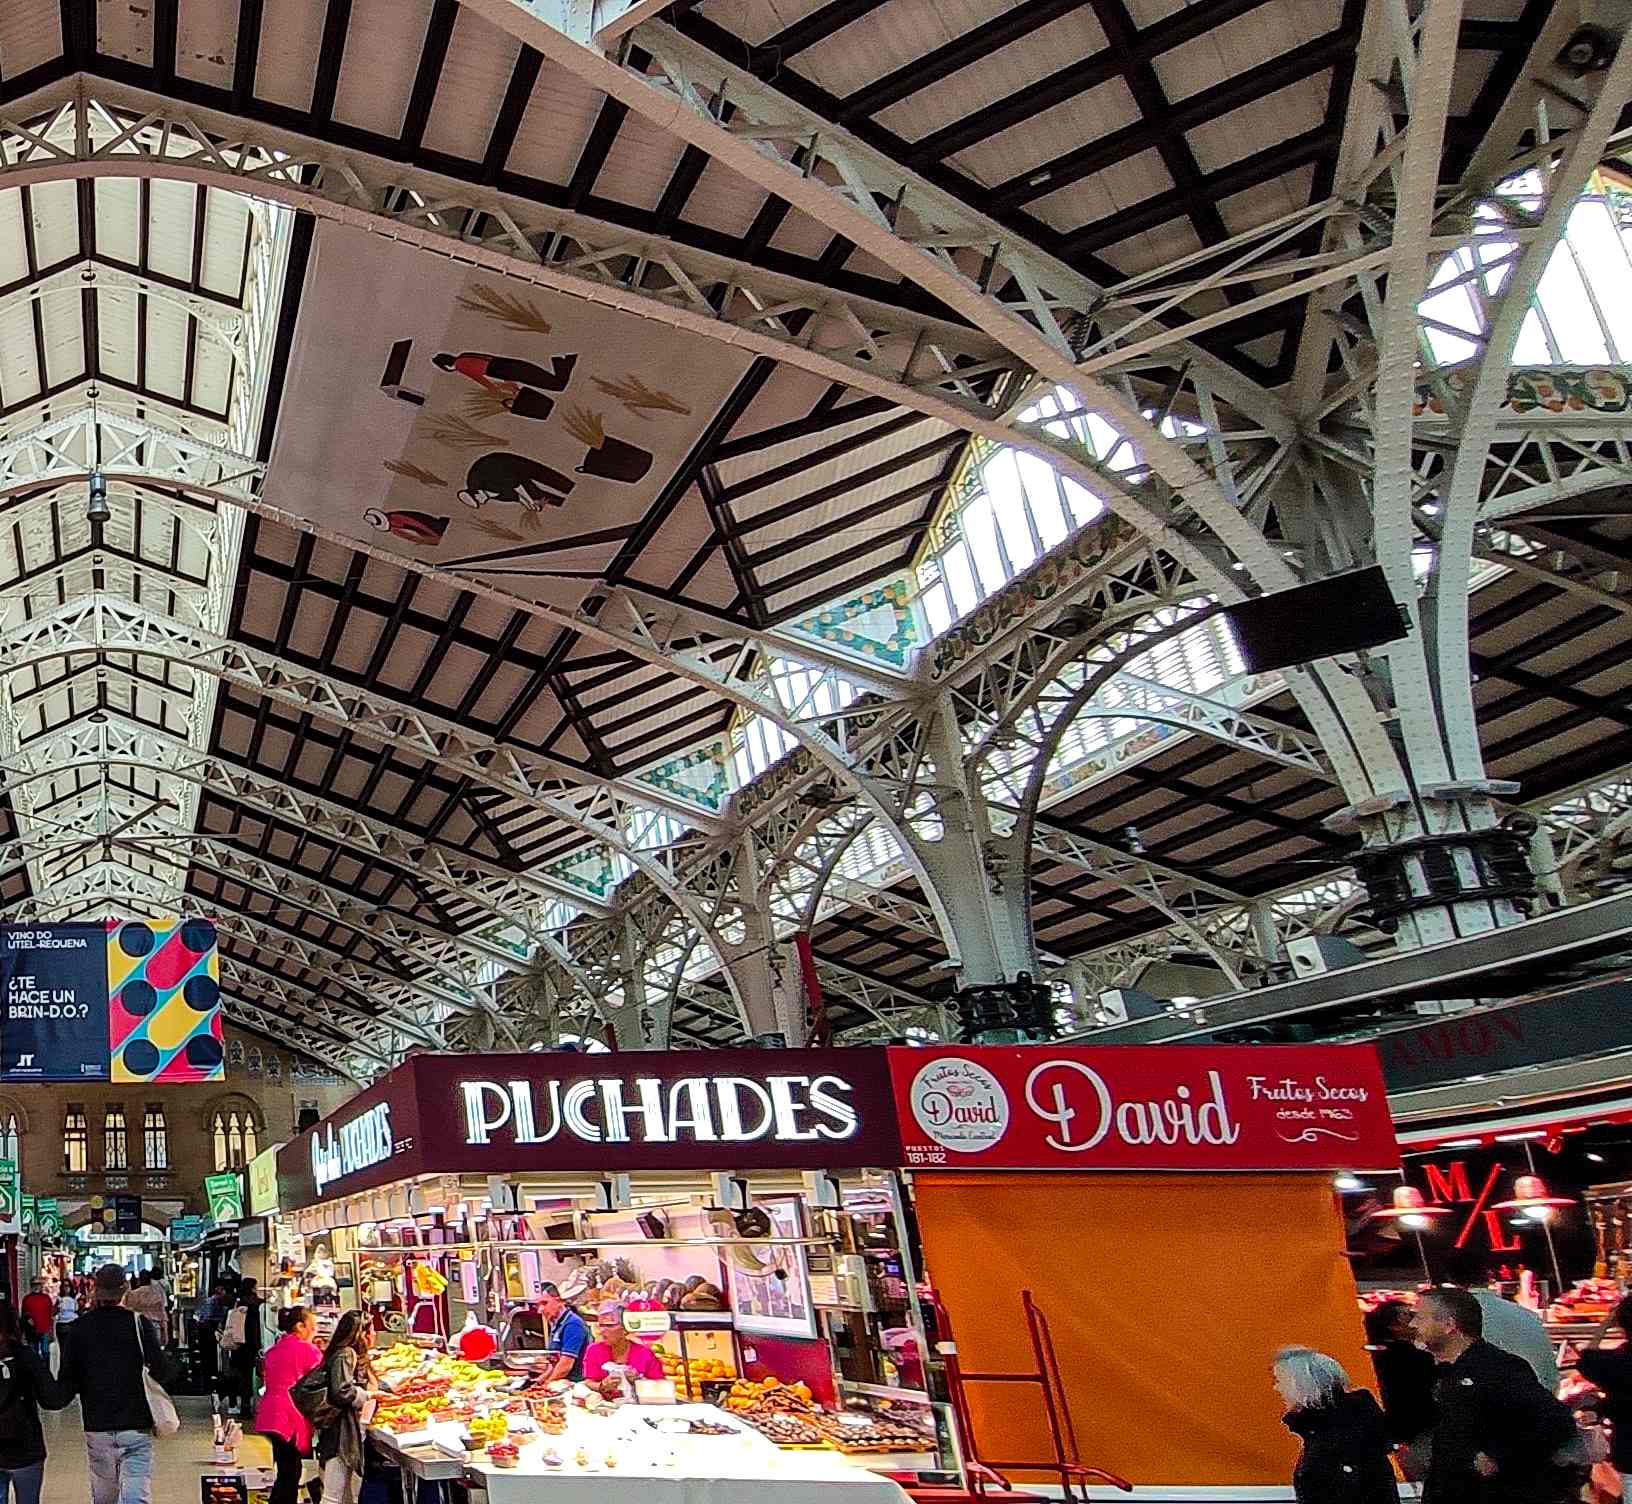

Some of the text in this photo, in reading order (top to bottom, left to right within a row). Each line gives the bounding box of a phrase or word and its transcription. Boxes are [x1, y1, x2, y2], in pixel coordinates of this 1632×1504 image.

[8, 931, 53, 940] VINO DO
[8, 939, 87, 949] UTIEL-REQUENA
[8, 976, 36, 990] ¿TE
[8, 990, 75, 1004] HACE UN
[8, 1004, 89, 1019] BRIN-D.O.?
[1246, 1076, 1368, 1102] Frutos Secos
[460, 1076, 858, 1144] PUCHADES
[920, 1091, 1000, 1126] David
[1024, 1060, 1241, 1152] David
[907, 1153, 947, 1164] 181-182
